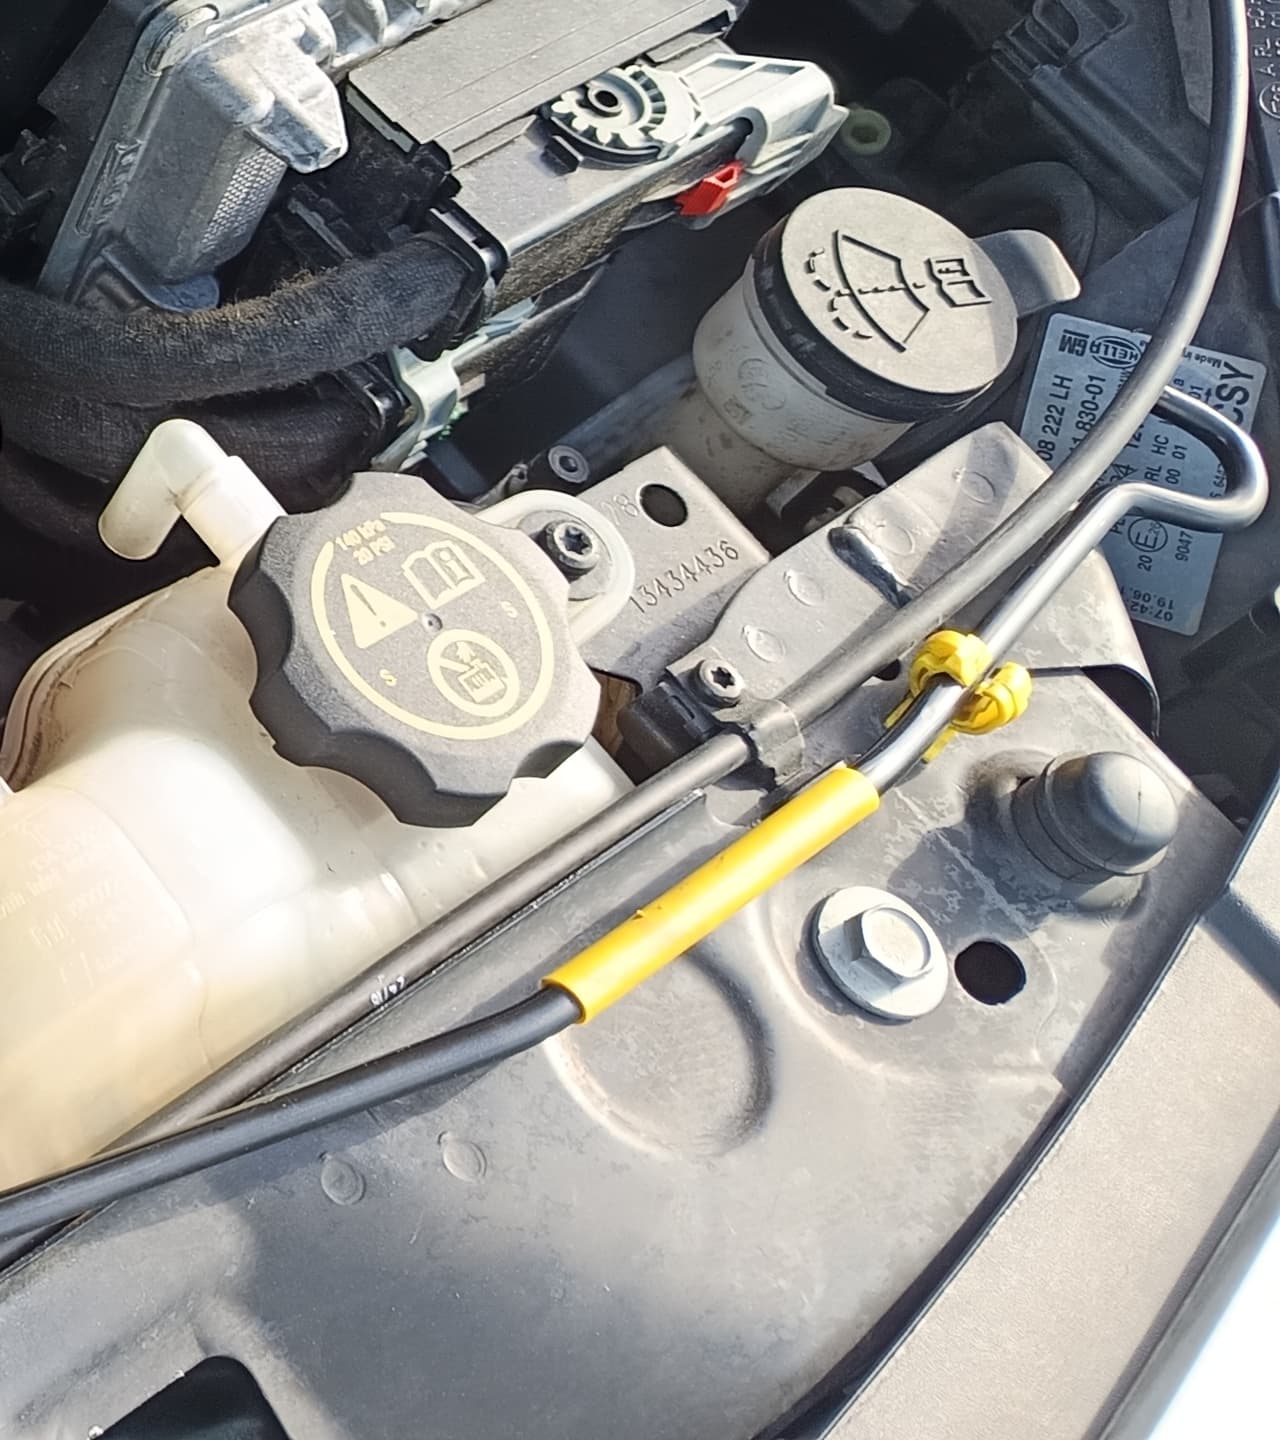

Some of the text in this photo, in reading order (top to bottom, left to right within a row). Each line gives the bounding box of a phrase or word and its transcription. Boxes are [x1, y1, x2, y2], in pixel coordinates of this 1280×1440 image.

[1090, 340, 1139, 361] HELLA
[1194, 353, 1222, 368] Made
[1049, 374, 1073, 400] LH
[1075, 374, 1107, 433] 830-01
[1042, 404, 1066, 437] 222
[1152, 434, 1169, 456] HC
[1172, 444, 1188, 461] 01
[1165, 468, 1181, 485] 00
[1175, 531, 1194, 562] 9047
[1137, 554, 1153, 572] 20
[629, 540, 739, 613] 13434436
